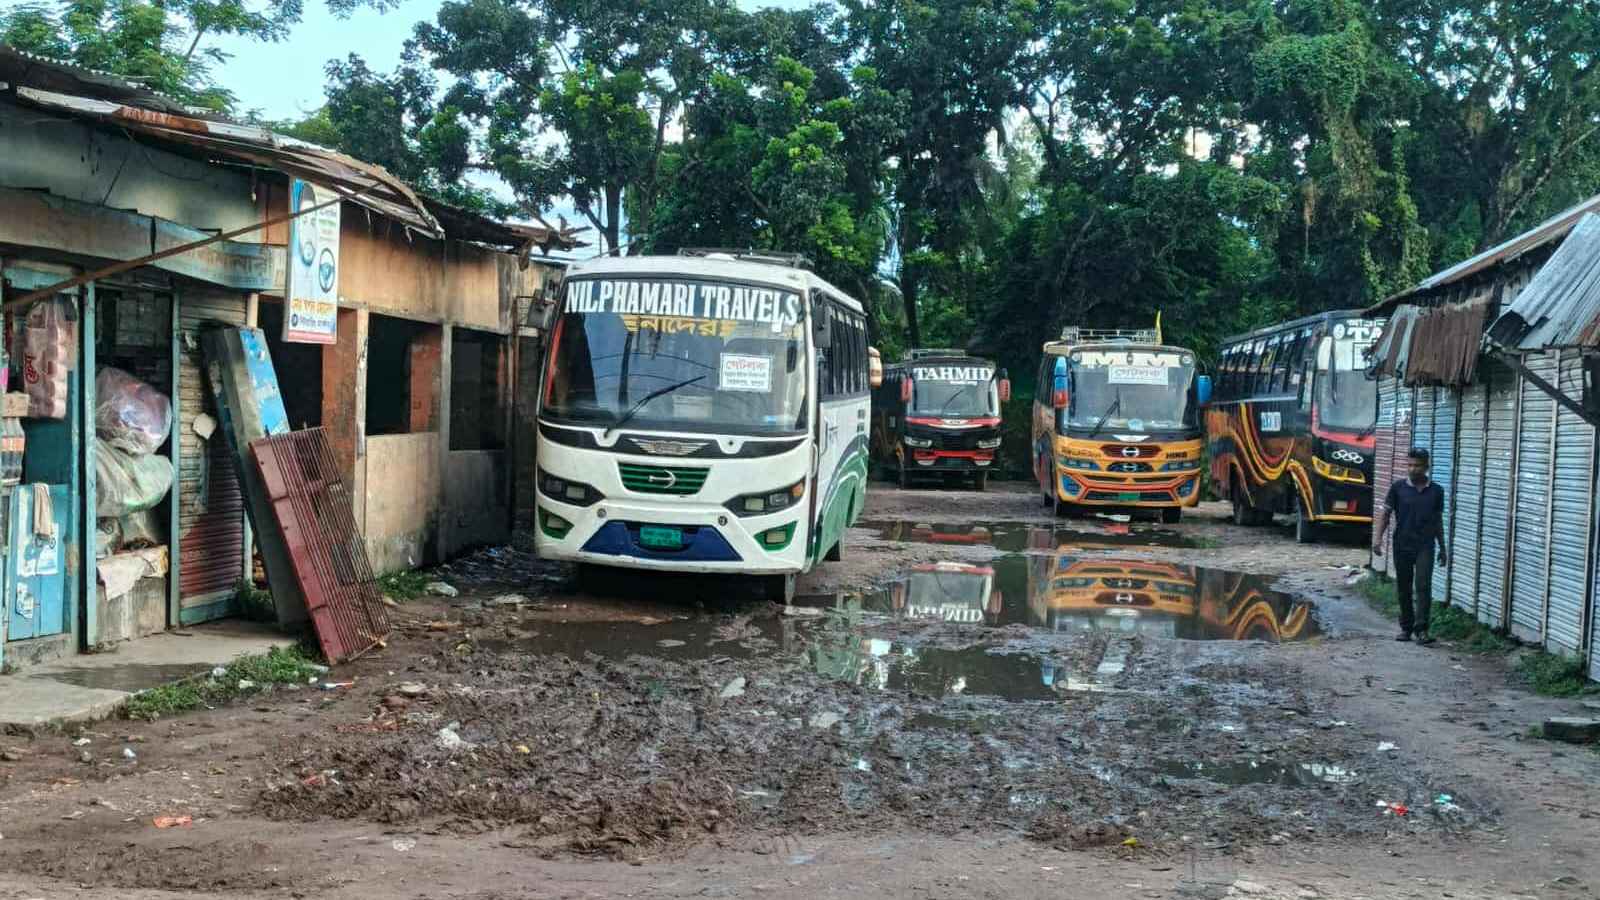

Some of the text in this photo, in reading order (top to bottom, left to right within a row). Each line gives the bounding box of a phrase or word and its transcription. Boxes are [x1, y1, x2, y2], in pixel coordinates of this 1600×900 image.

[565, 281, 799, 327] NILPHAMARI TRAVELS
[912, 366, 993, 381] TAHMID
